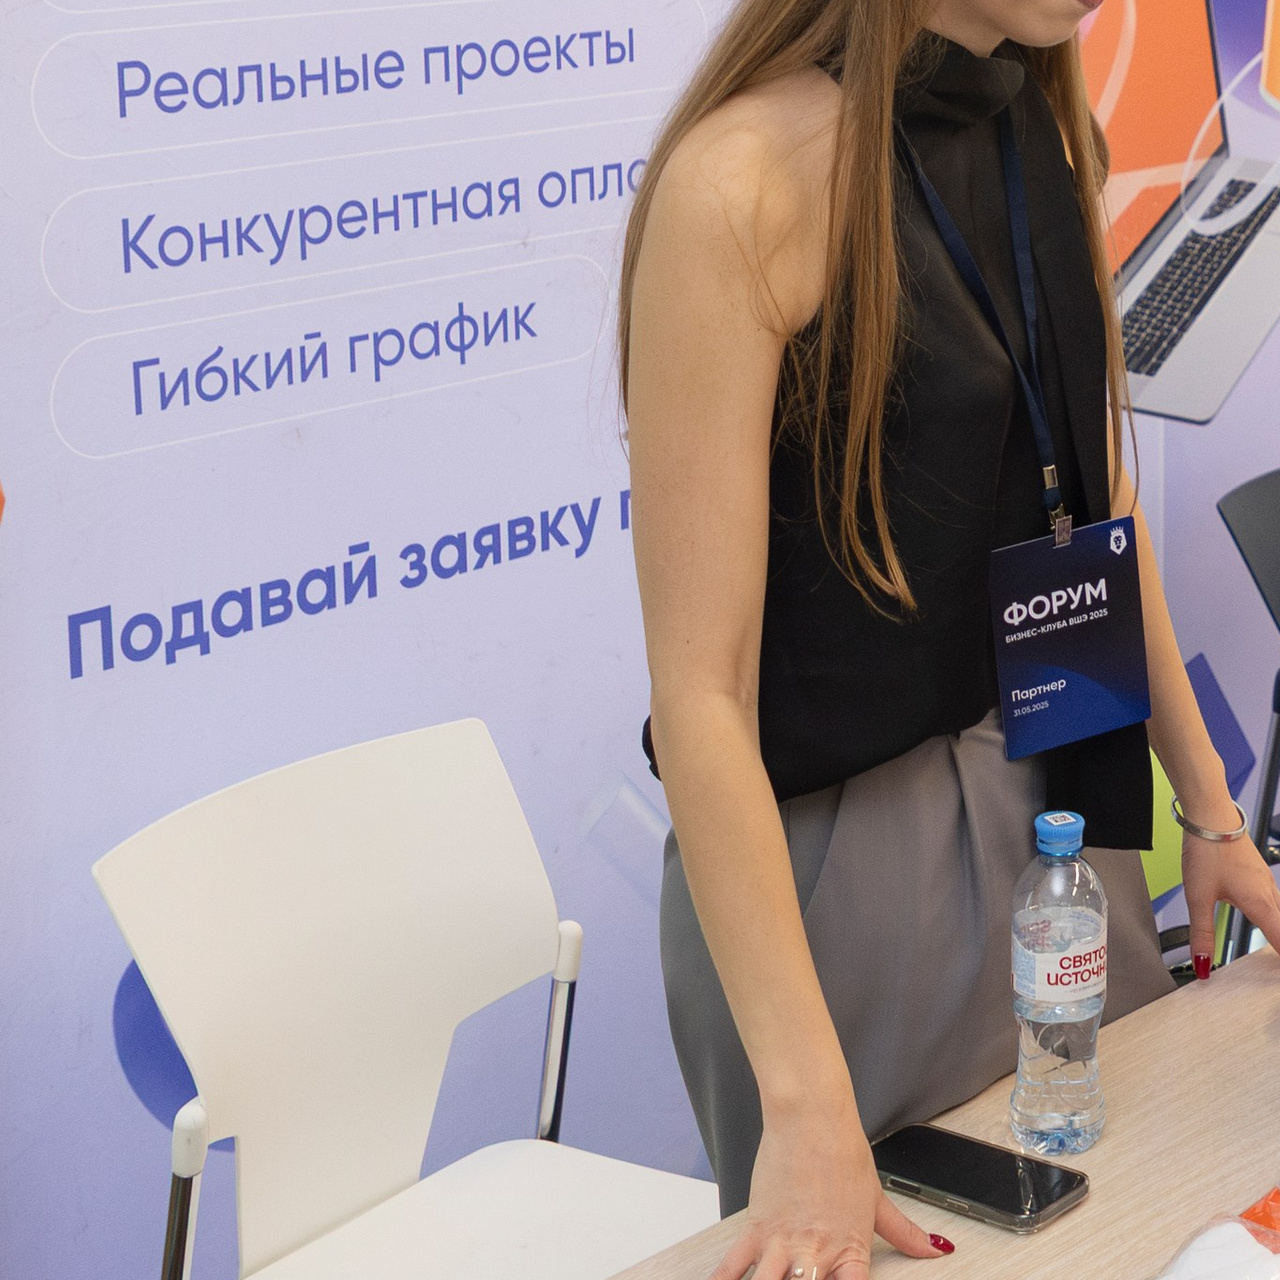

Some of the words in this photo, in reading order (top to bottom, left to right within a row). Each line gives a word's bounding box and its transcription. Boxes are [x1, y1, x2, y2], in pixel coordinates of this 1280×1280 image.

[115, 46, 406, 118] Реальные
[423, 26, 637, 93] проекты
[119, 177, 523, 275] Конкурентная
[131, 332, 330, 417] Гибкий
[348, 301, 538, 383] график
[66, 543, 379, 680] Подавай
[399, 495, 602, 588] заявку
[1003, 578, 1108, 626] ФОРУМ
[1005, 619, 1068, 644] БИЗНЕС-КЛУБА
[1068, 613, 1088, 626] ВШЭ
[1088, 607, 1108, 622] 2025
[1011, 678, 1067, 702] Партнер
[1013, 700, 1049, 717] 31.05.2025
